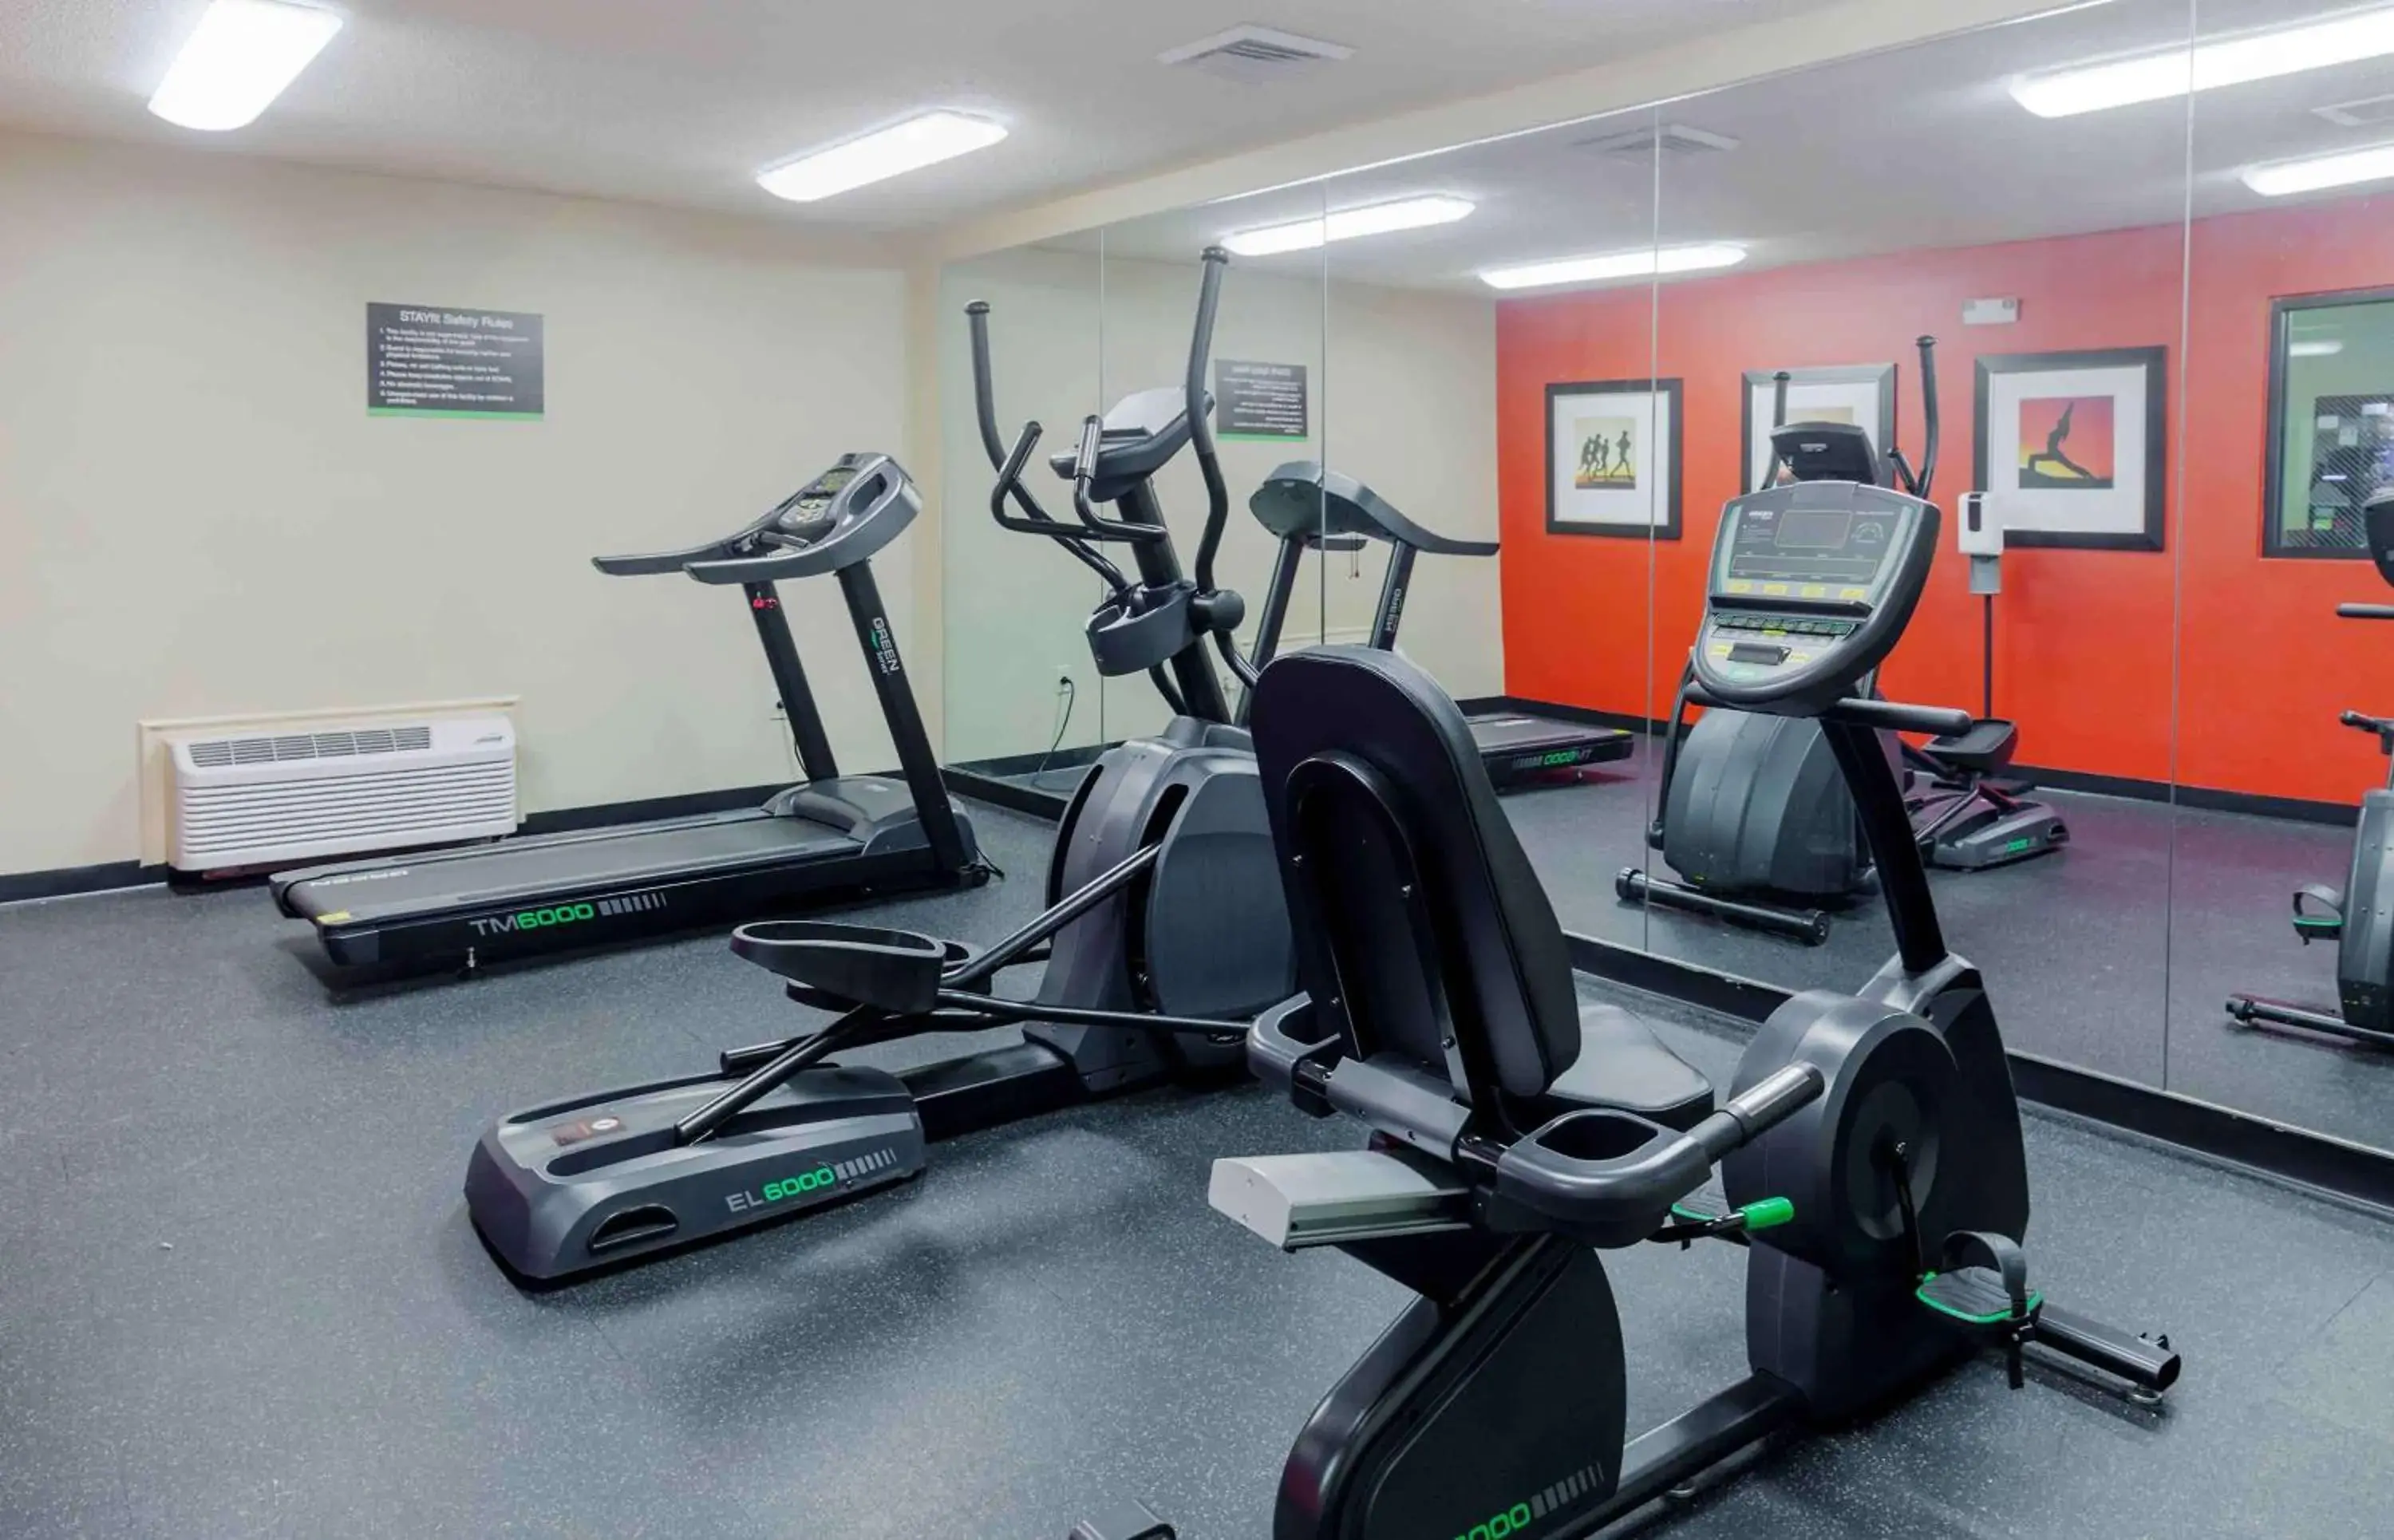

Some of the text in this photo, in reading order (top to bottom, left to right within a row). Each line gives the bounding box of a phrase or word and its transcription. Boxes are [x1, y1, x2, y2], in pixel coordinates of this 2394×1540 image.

[872, 617, 900, 671] GREEN
[468, 902, 595, 936] TM6000
[725, 1167, 836, 1213] EL6000
[1454, 1502, 1531, 1540] 000
